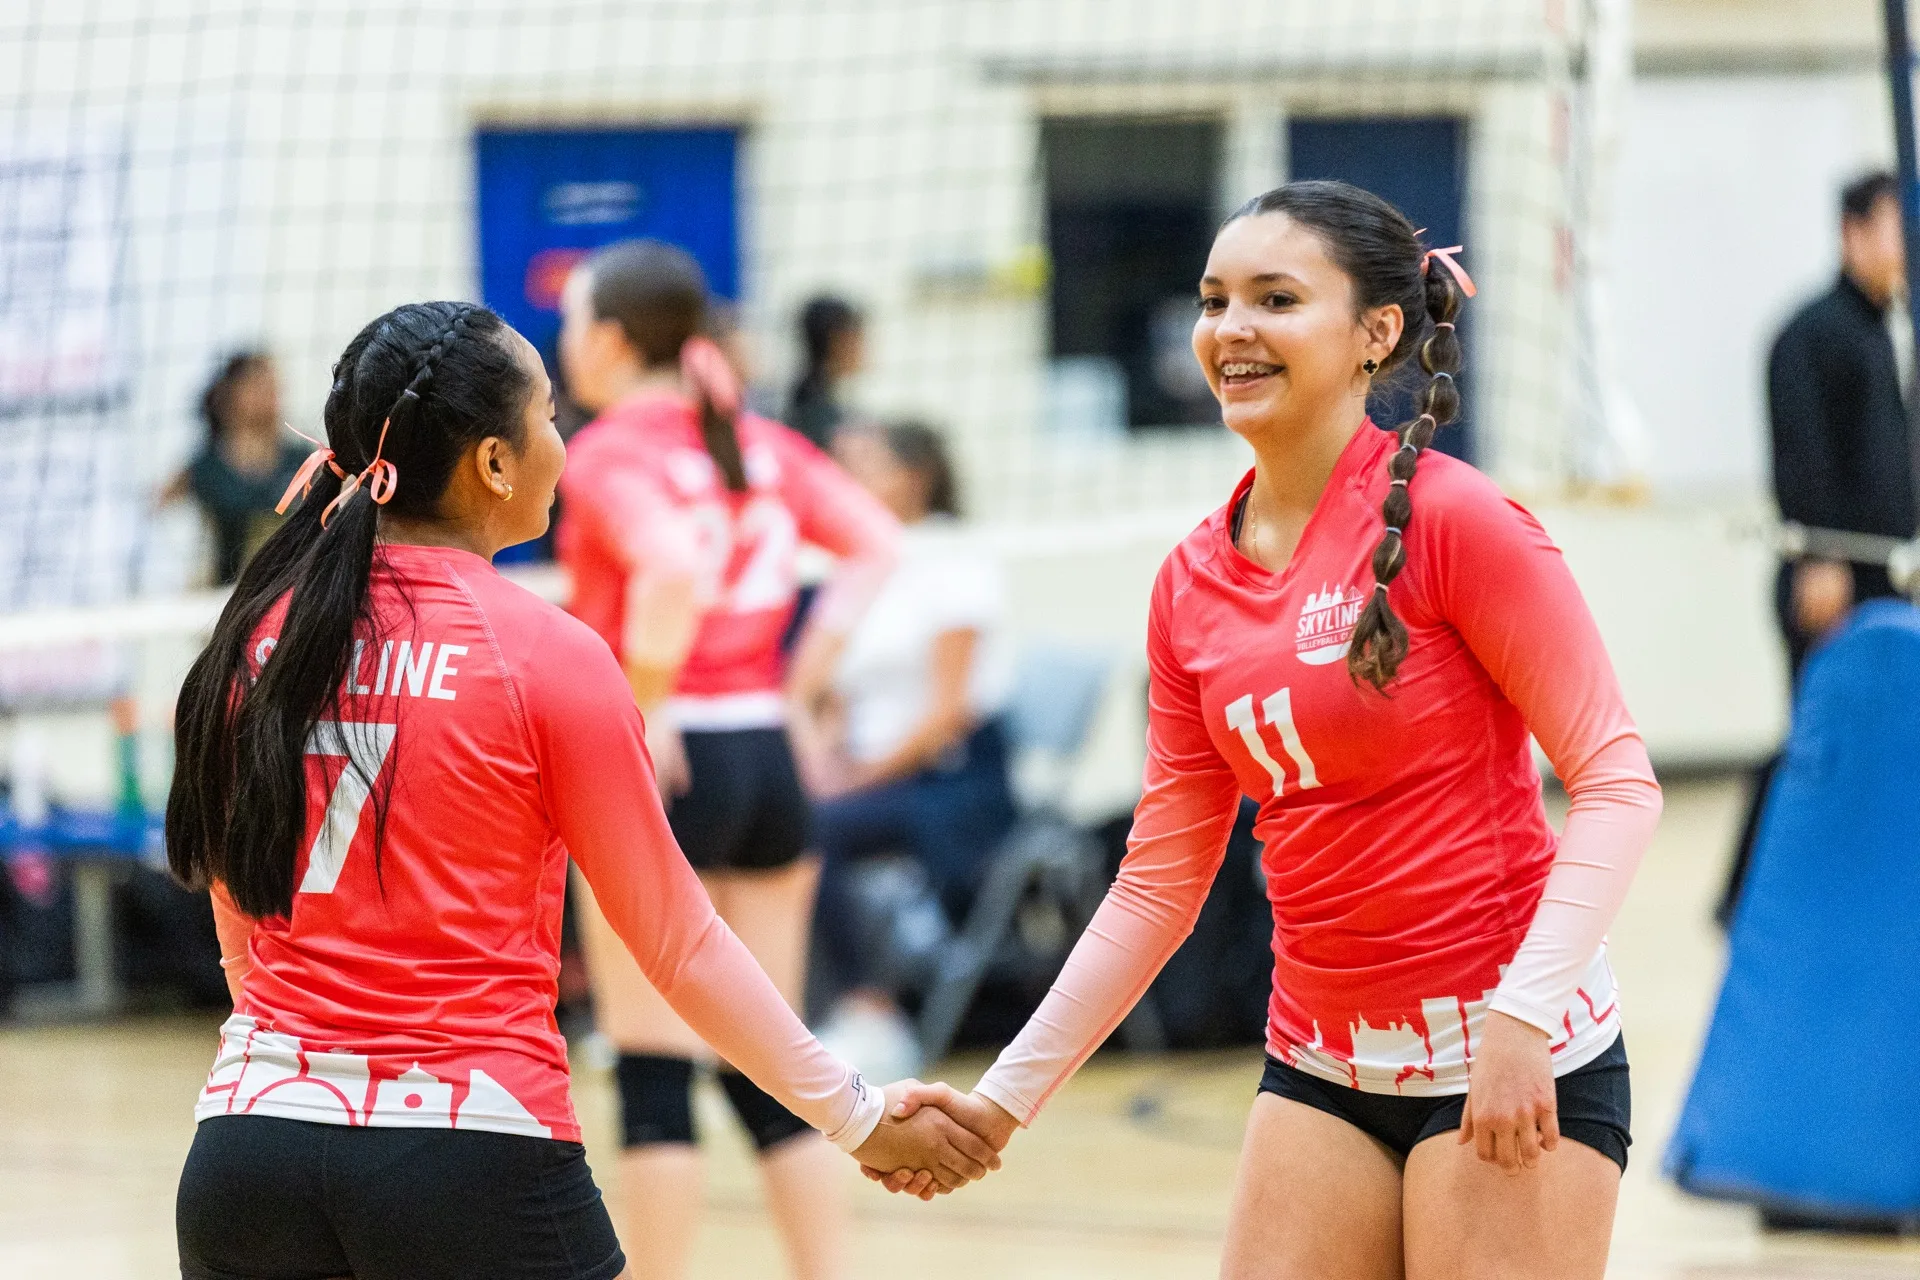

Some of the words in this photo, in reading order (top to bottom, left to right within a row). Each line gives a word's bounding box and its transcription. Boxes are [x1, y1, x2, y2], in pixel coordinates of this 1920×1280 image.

[1296, 600, 1363, 638] SKYLINE
[1297, 634, 1339, 651] VOLLEYBALL
[250, 637, 468, 701] LINE
[1225, 687, 1324, 797] 11
[298, 719, 397, 894] 7
